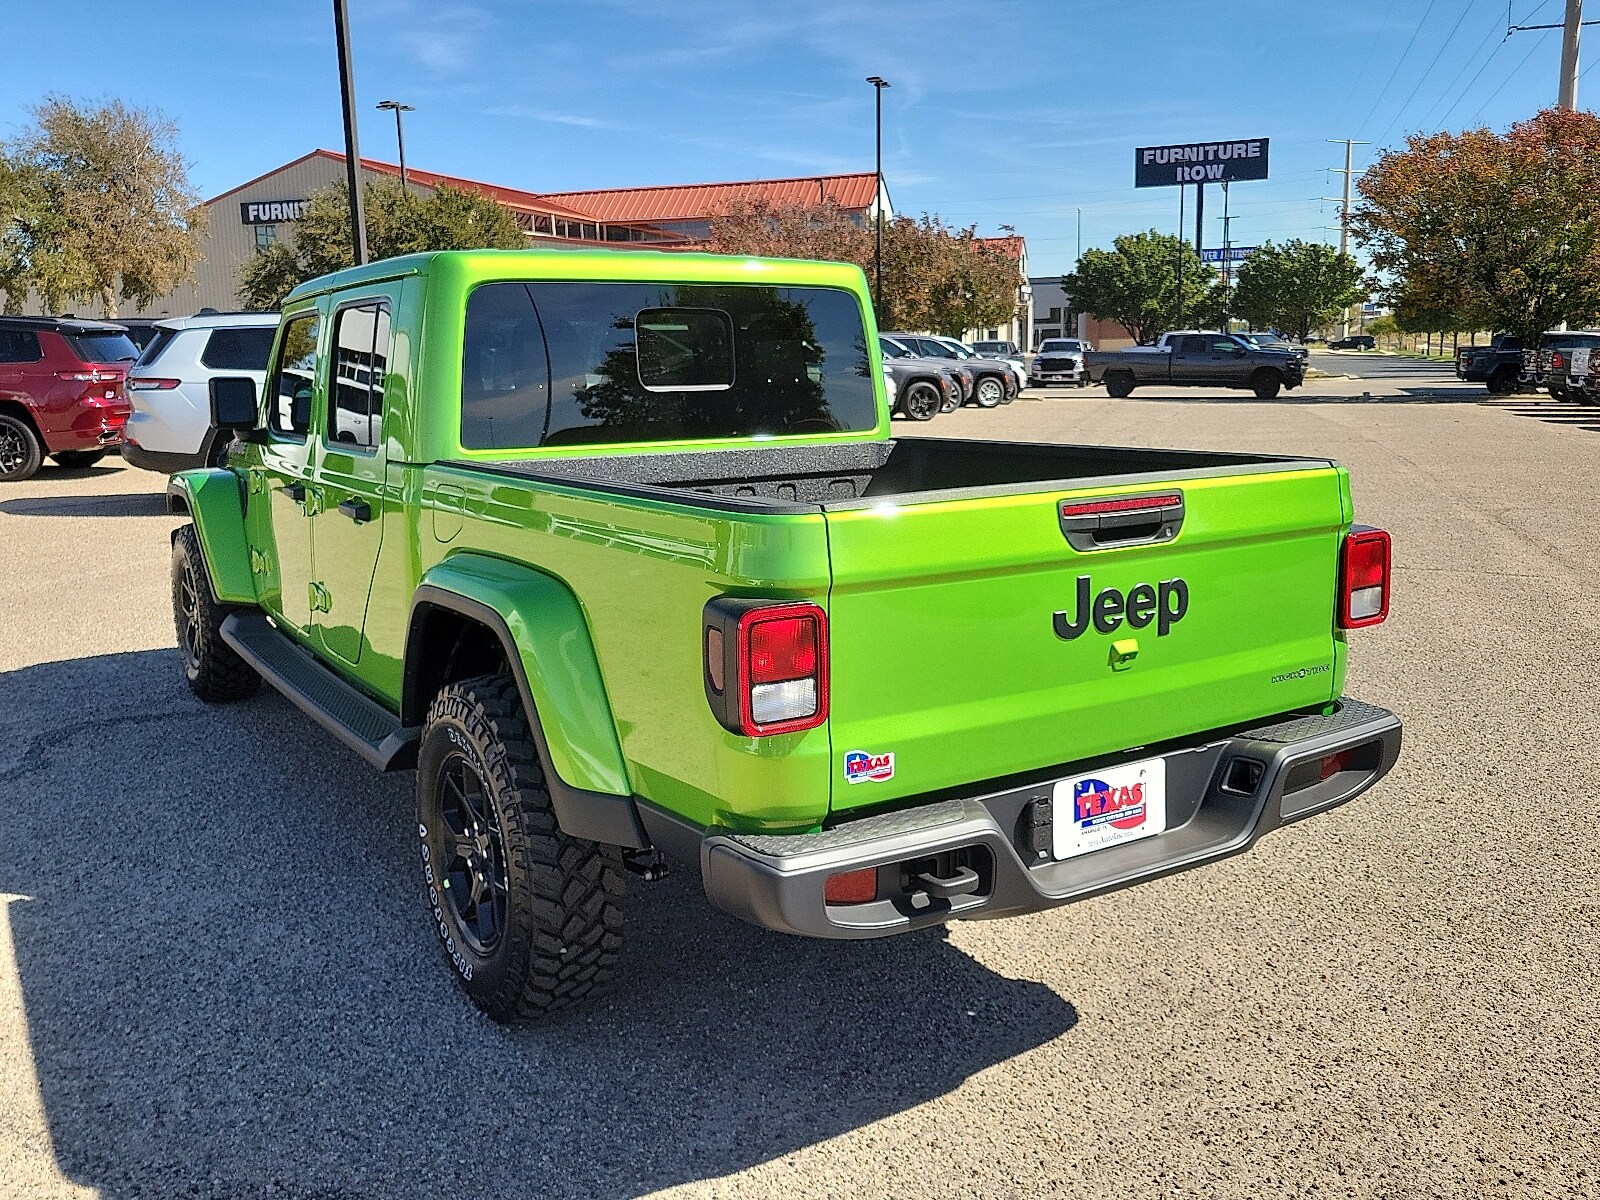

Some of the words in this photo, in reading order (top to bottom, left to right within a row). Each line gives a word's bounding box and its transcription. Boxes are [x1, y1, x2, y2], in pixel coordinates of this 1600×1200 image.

[1143, 142, 1260, 165] FURNITURE
[1176, 164, 1225, 181] ROW
[248, 202, 307, 221] FURNI
[1053, 574, 1189, 642] Jeep
[848, 755, 890, 774] TEXAS
[1077, 782, 1143, 819] TEXAS
